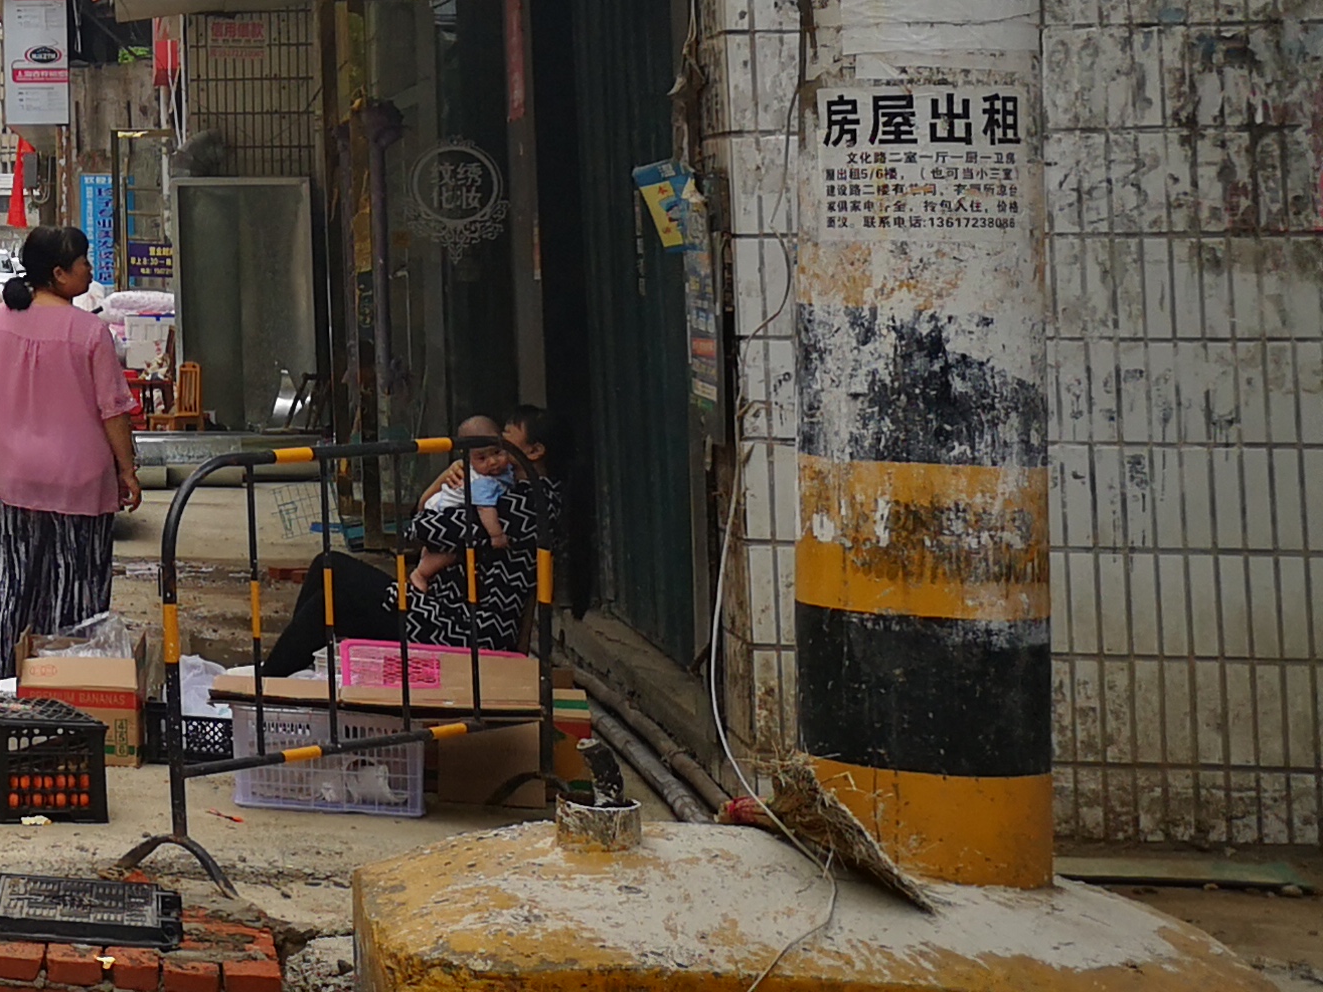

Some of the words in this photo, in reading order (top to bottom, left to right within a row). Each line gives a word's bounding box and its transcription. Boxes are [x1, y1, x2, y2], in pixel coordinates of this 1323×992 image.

[822, 93, 1021, 148] 房屋出租
[79, 692, 126, 706] BANANAS
